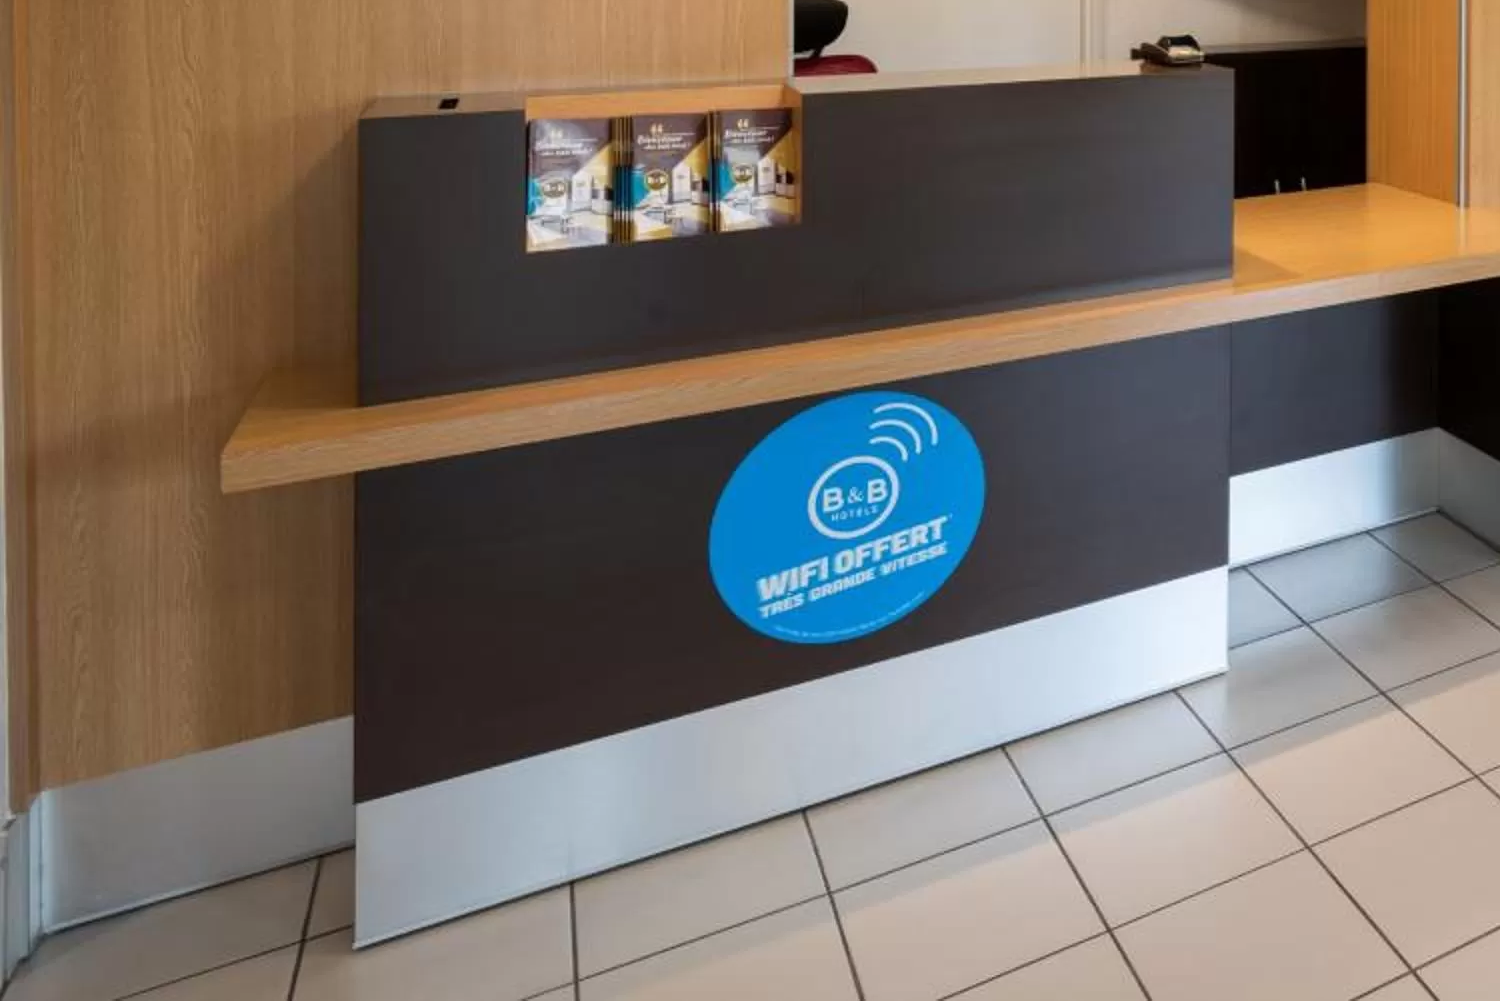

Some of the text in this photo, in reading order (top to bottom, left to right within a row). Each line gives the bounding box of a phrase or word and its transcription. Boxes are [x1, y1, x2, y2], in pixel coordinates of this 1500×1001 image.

[822, 478, 889, 514] B&B
[831, 505, 879, 522] HOTELS
[756, 555, 829, 601] WIFI
[758, 590, 805, 619] TRÈS
[808, 567, 877, 602] GRANDE
[879, 541, 948, 577] VITESSE
